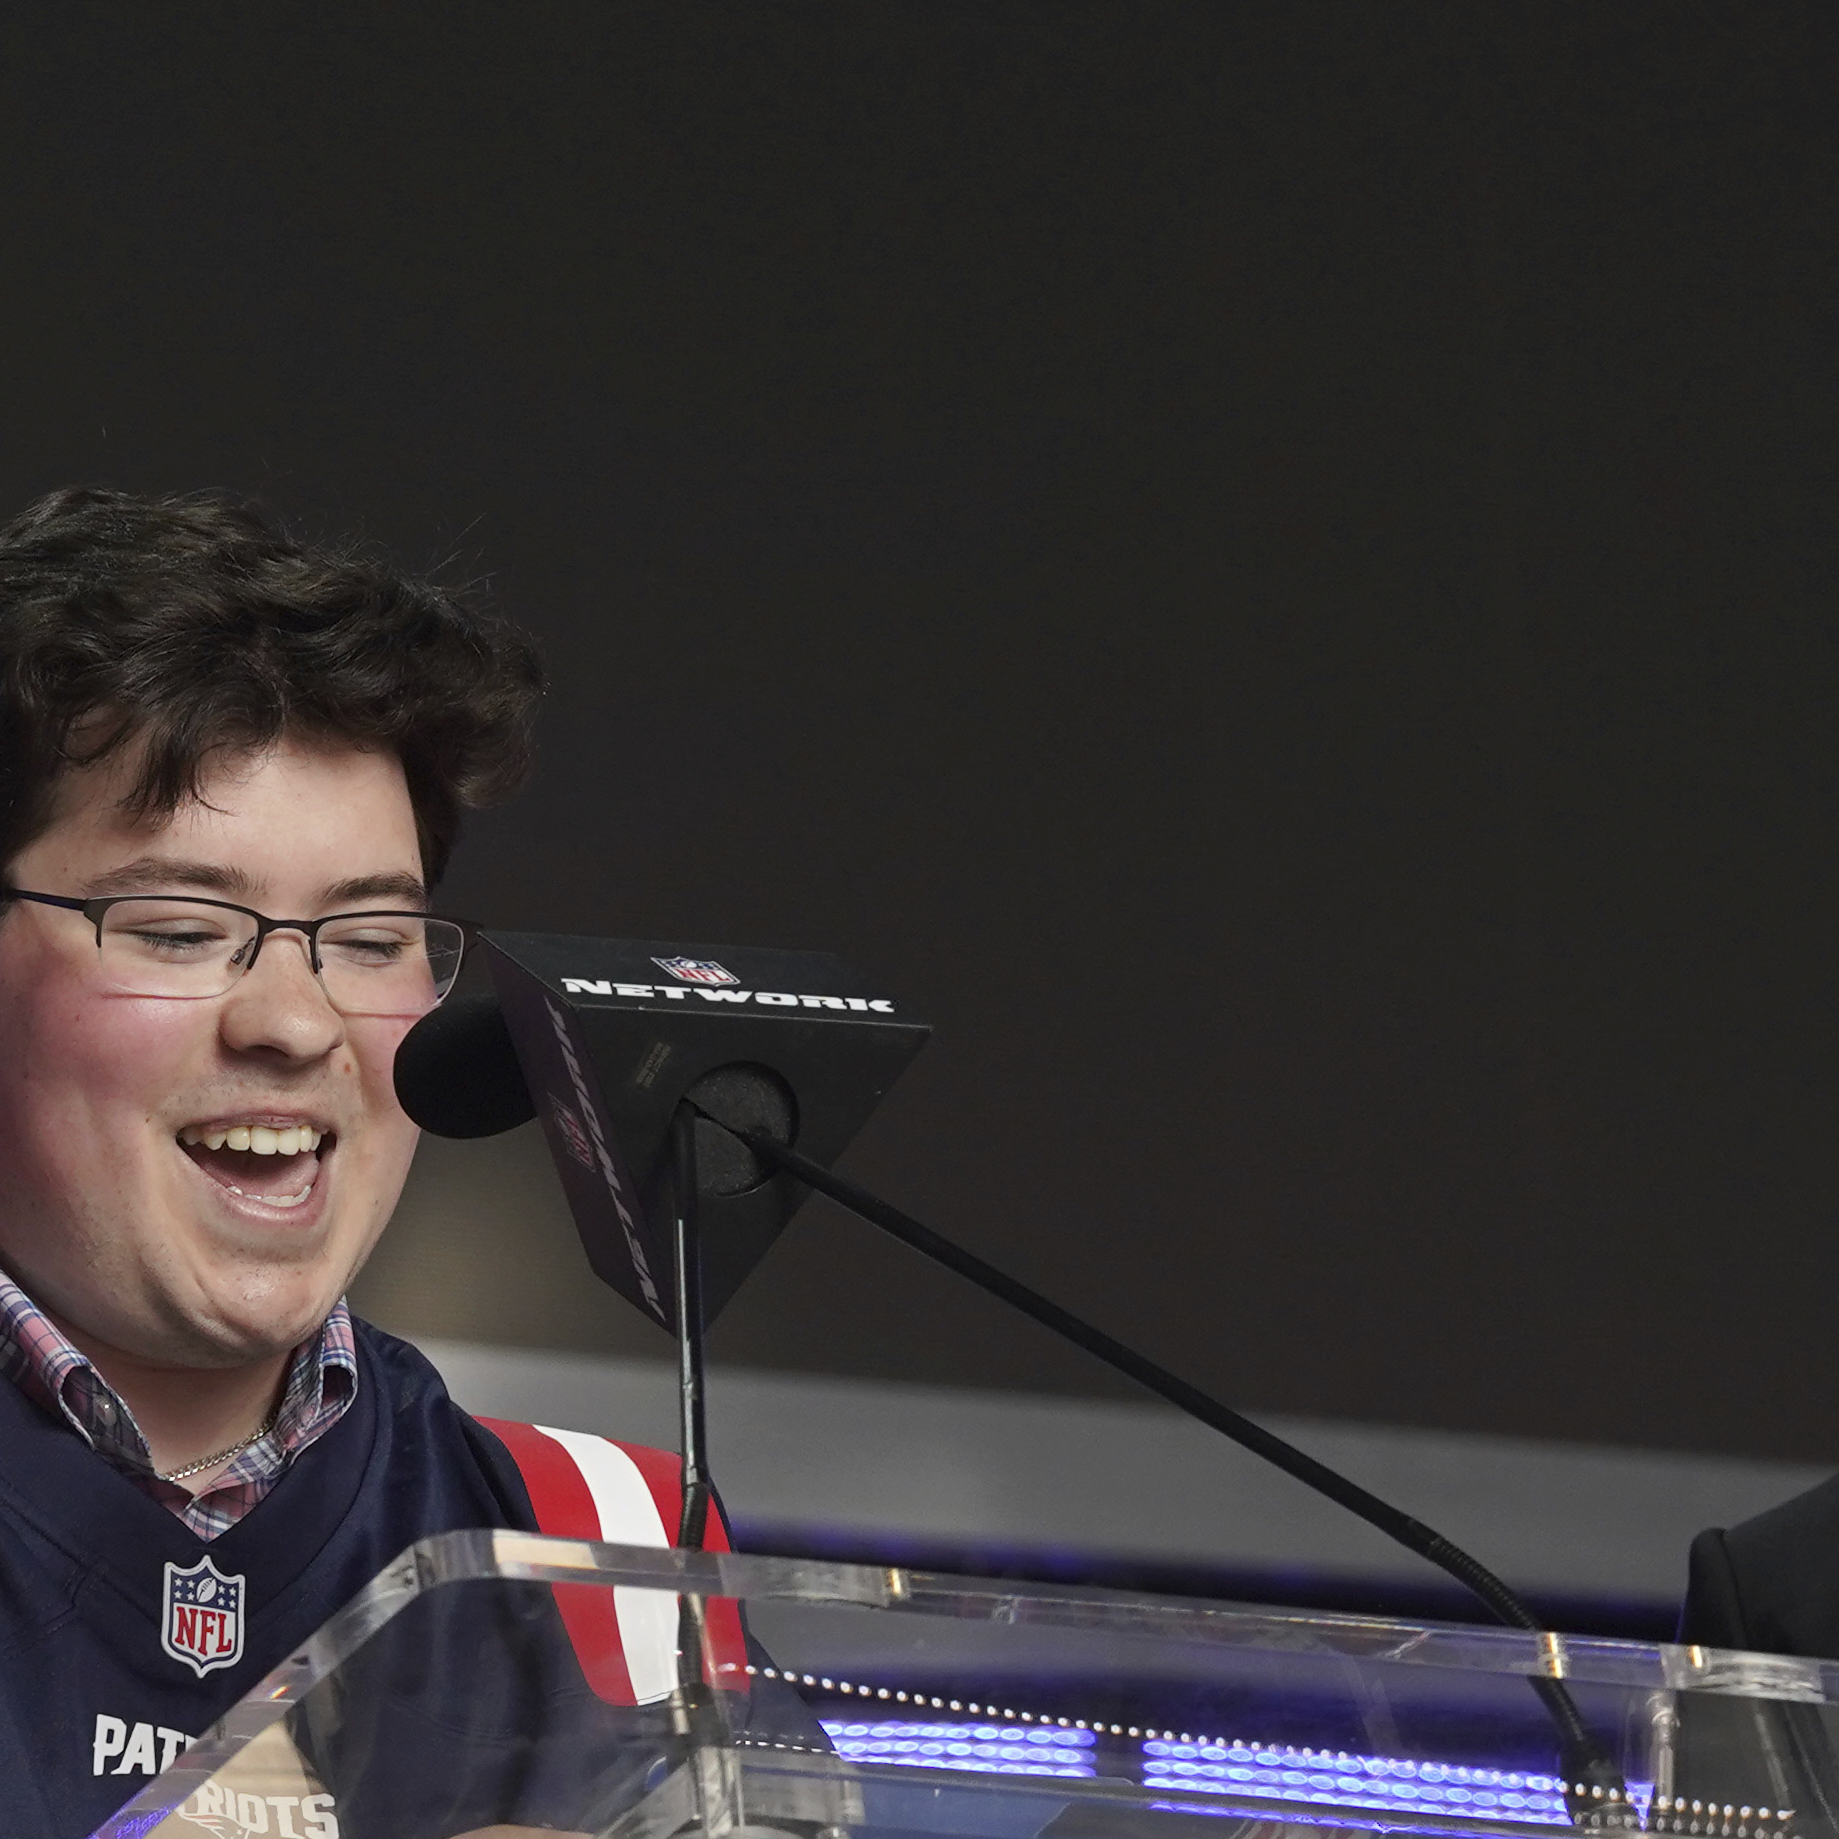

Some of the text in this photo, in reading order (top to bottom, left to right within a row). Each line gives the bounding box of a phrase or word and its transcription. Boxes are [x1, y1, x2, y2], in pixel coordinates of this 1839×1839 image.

[677, 968, 730, 982] NFL
[561, 977, 895, 1013] NETWORK
[174, 1606, 233, 1656] NFL
